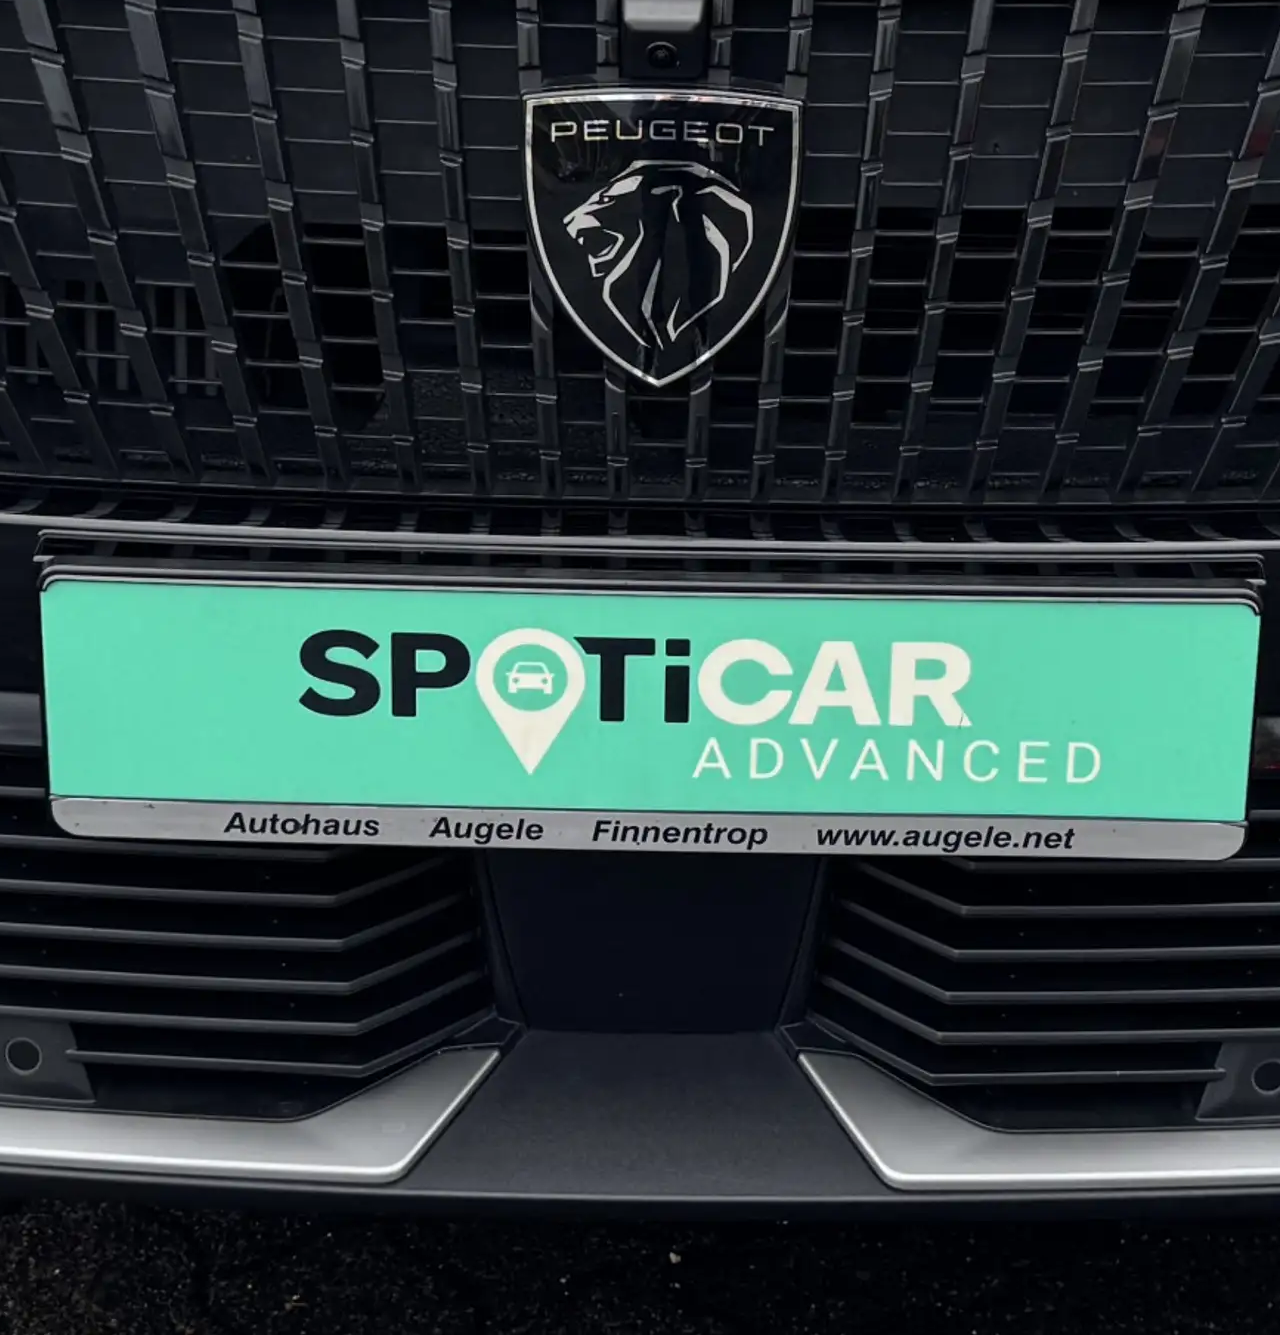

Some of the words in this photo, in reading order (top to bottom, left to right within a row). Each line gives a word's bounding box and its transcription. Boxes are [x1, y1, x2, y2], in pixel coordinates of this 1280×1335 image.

[550, 119, 775, 147] PEUGEOT
[691, 737, 1102, 785] ADVANCED
[223, 811, 381, 838] Autohaus
[428, 816, 545, 845] Augele
[591, 819, 769, 850] Finnentrop
[816, 825, 1075, 853] www.augele.net
